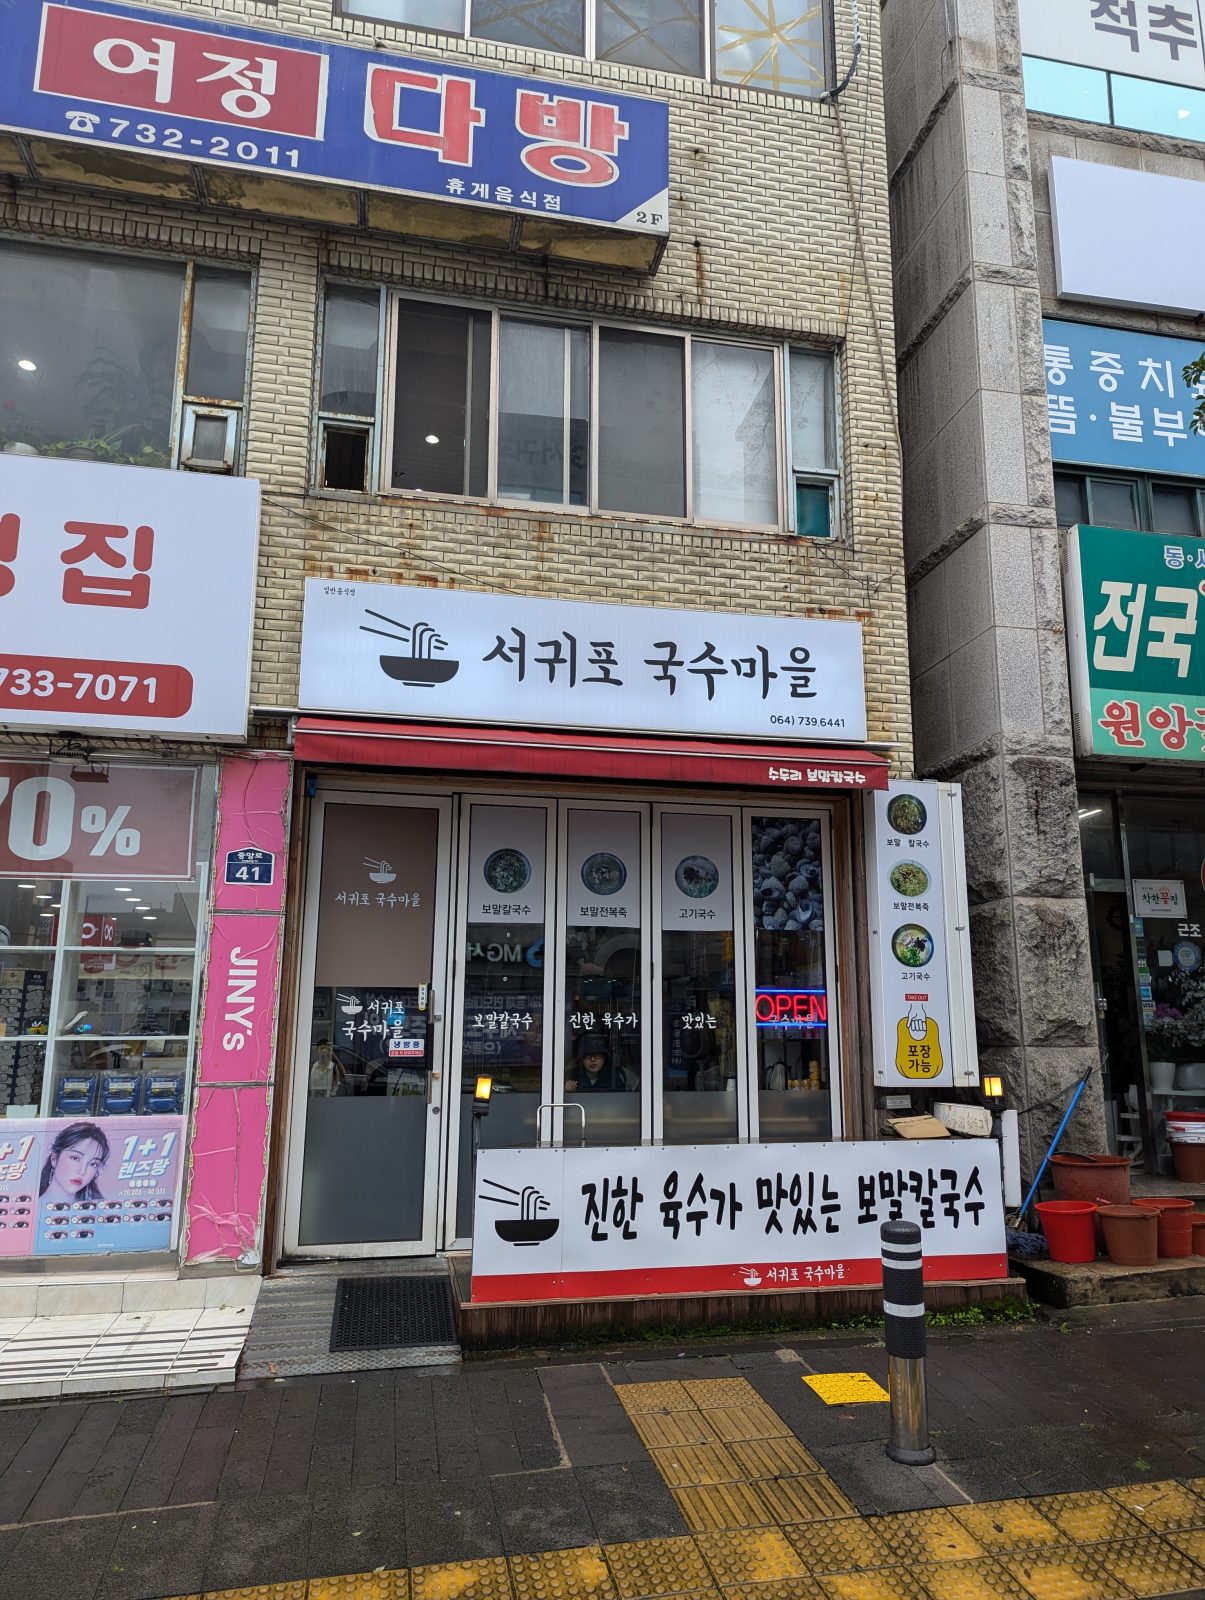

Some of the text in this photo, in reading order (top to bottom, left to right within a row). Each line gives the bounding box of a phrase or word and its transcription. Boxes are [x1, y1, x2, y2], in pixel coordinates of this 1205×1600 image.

[93, 37, 630, 188] 여정 다방
[109, 117, 301, 168] 732-2011
[445, 177, 563, 211] 휴게음식점
[636, 209, 664, 226] 2F
[1043, 343, 1205, 399] 통증치
[482, 626, 818, 701] 서귀포 국수마을
[769, 714, 795, 726] 064)
[1099, 699, 1205, 751] 원앙
[768, 766, 867, 784] 수두리 보말칼국수
[886, 838, 930, 848] 보말 칼국수
[237, 852, 264, 860] 중앙로
[235, 866, 260, 881] 41
[335, 890, 421, 909] 서귀포 국수마을
[893, 902, 930, 912] 보말전복죽
[481, 903, 532, 916] 보말칼국수
[579, 905, 628, 919] 보말전복죽
[678, 908, 716, 920] 고기국수
[901, 972, 931, 981] 고기국수
[222, 946, 259, 1052] JINY'S
[367, 999, 405, 1016] 서귀포
[755, 993, 827, 1021] OPEN
[472, 1011, 533, 1031] 보말칼국수
[568, 1012, 639, 1030] 진한 육수가
[681, 1012, 717, 1030] 맛있는
[342, 1019, 404, 1042] 국수마을
[393, 1041, 420, 1049] 냉방중
[907, 1043, 931, 1058] 포장
[908, 1058, 932, 1073] 가능
[122, 1131, 178, 1163] 1+1
[118, 1157, 171, 1180] 렌즈랑
[581, 1165, 986, 1241] 진한 육수가 맛있는 보말칼국수
[766, 1263, 845, 1283] 서귀포 국수마을
